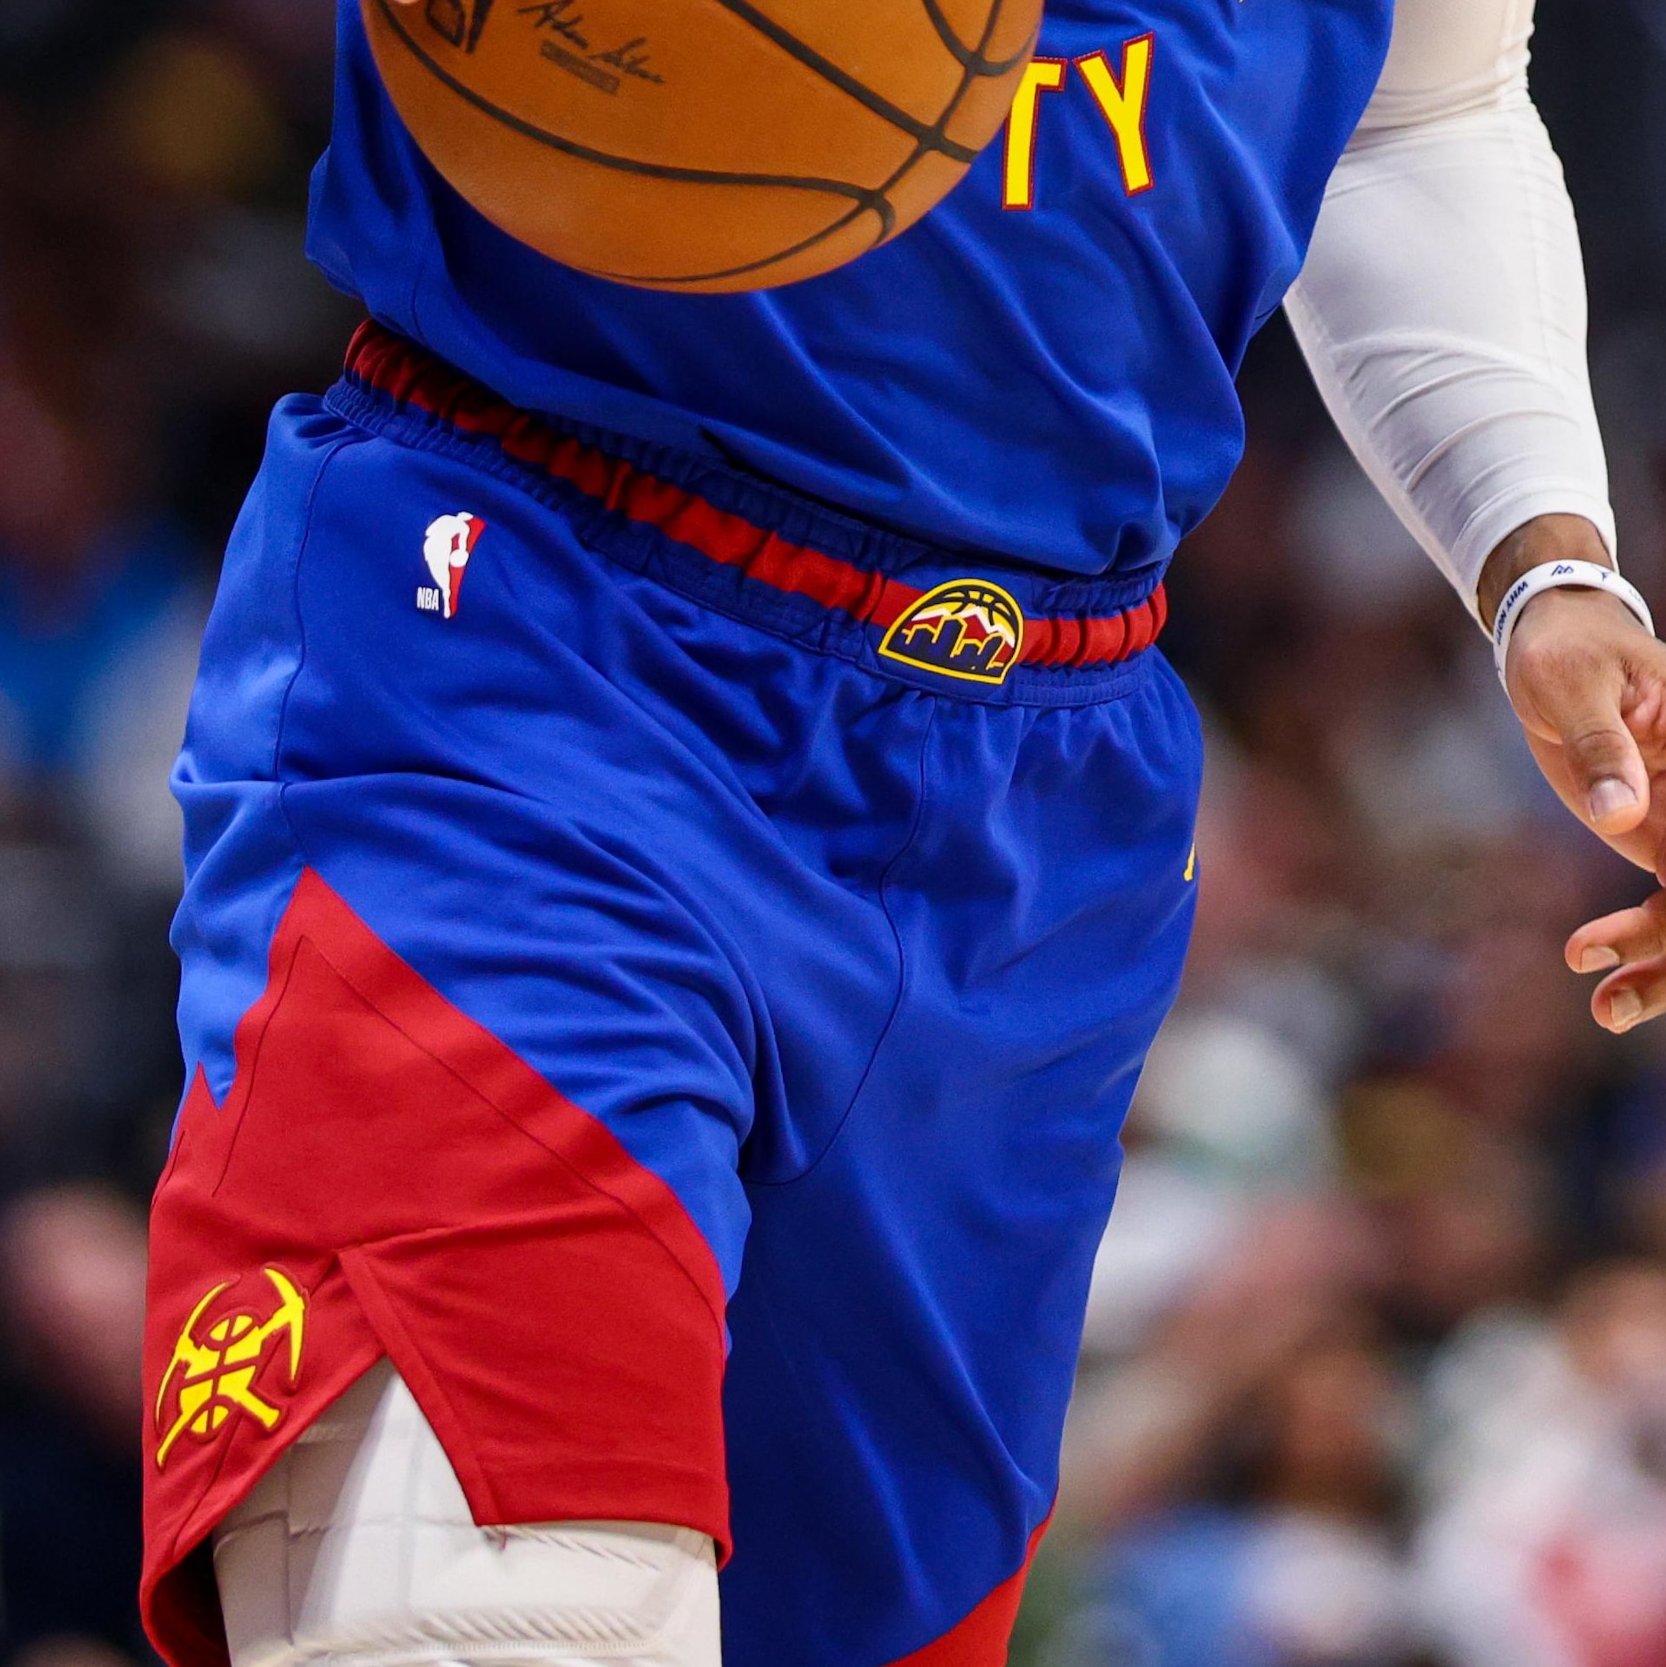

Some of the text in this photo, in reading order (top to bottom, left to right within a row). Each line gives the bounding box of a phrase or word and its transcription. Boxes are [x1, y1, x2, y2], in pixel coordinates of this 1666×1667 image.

[1001, 31, 1154, 211] TY
[417, 586, 439, 611] NBA
[1506, 580, 1529, 610] WHY
